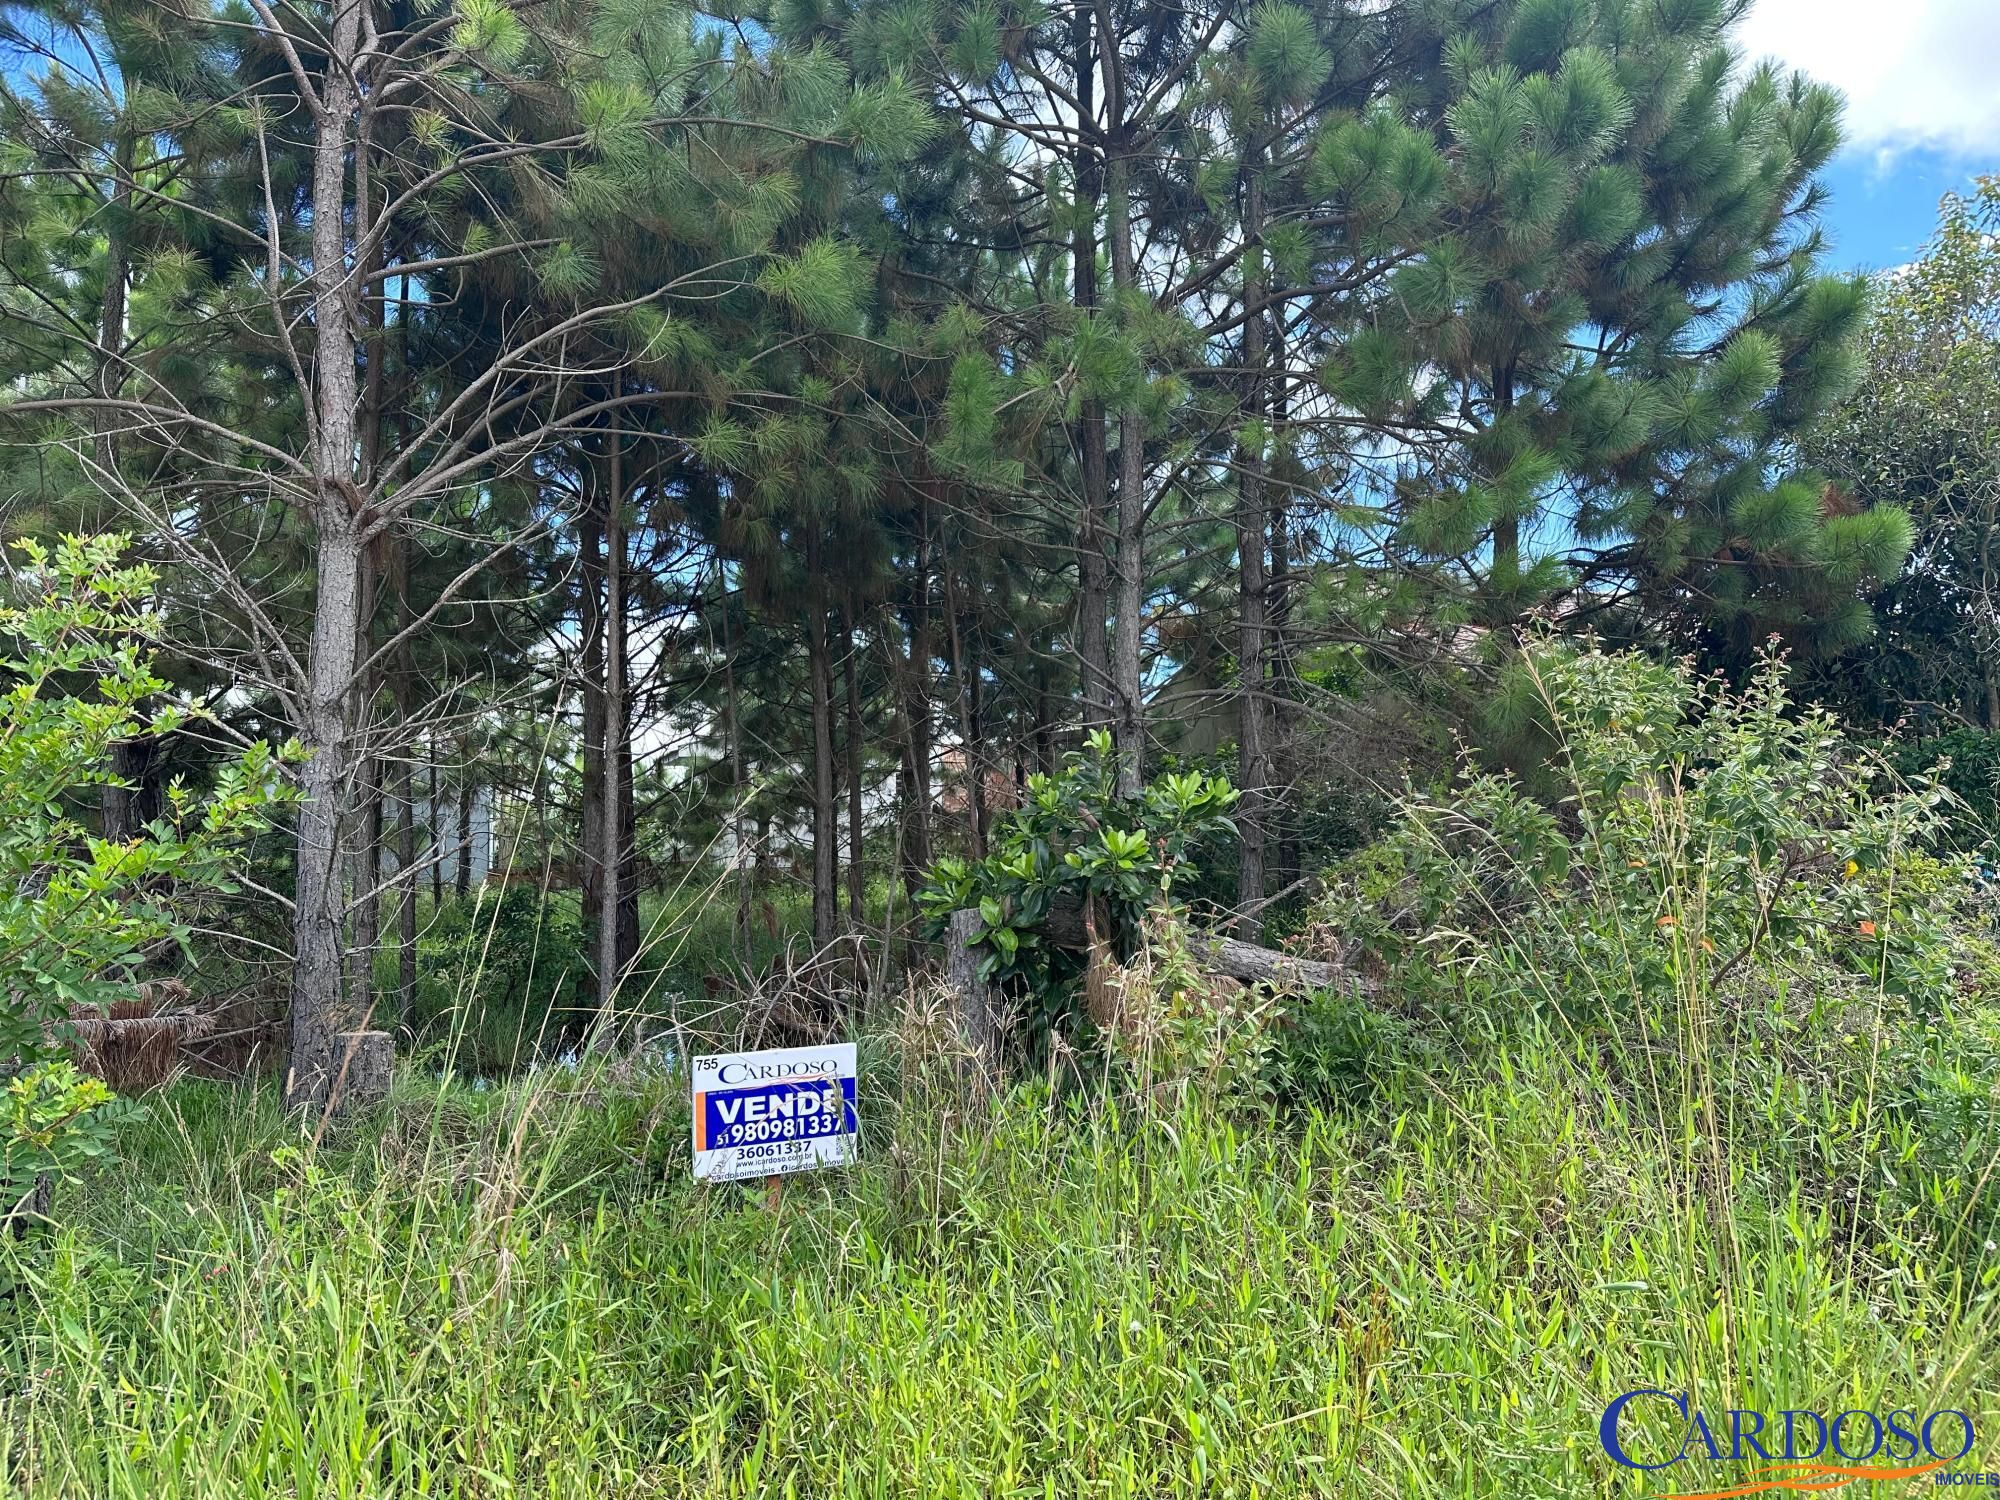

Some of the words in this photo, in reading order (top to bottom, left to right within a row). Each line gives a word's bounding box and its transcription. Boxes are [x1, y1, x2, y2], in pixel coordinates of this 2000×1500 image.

[696, 1058, 719, 1071] 755
[718, 1059, 838, 1085] CARDOSO
[715, 1088, 844, 1125] VENDE
[717, 1134, 730, 1146] 51
[731, 1113, 844, 1144] 980981337
[737, 1140, 812, 1160] 36061337
